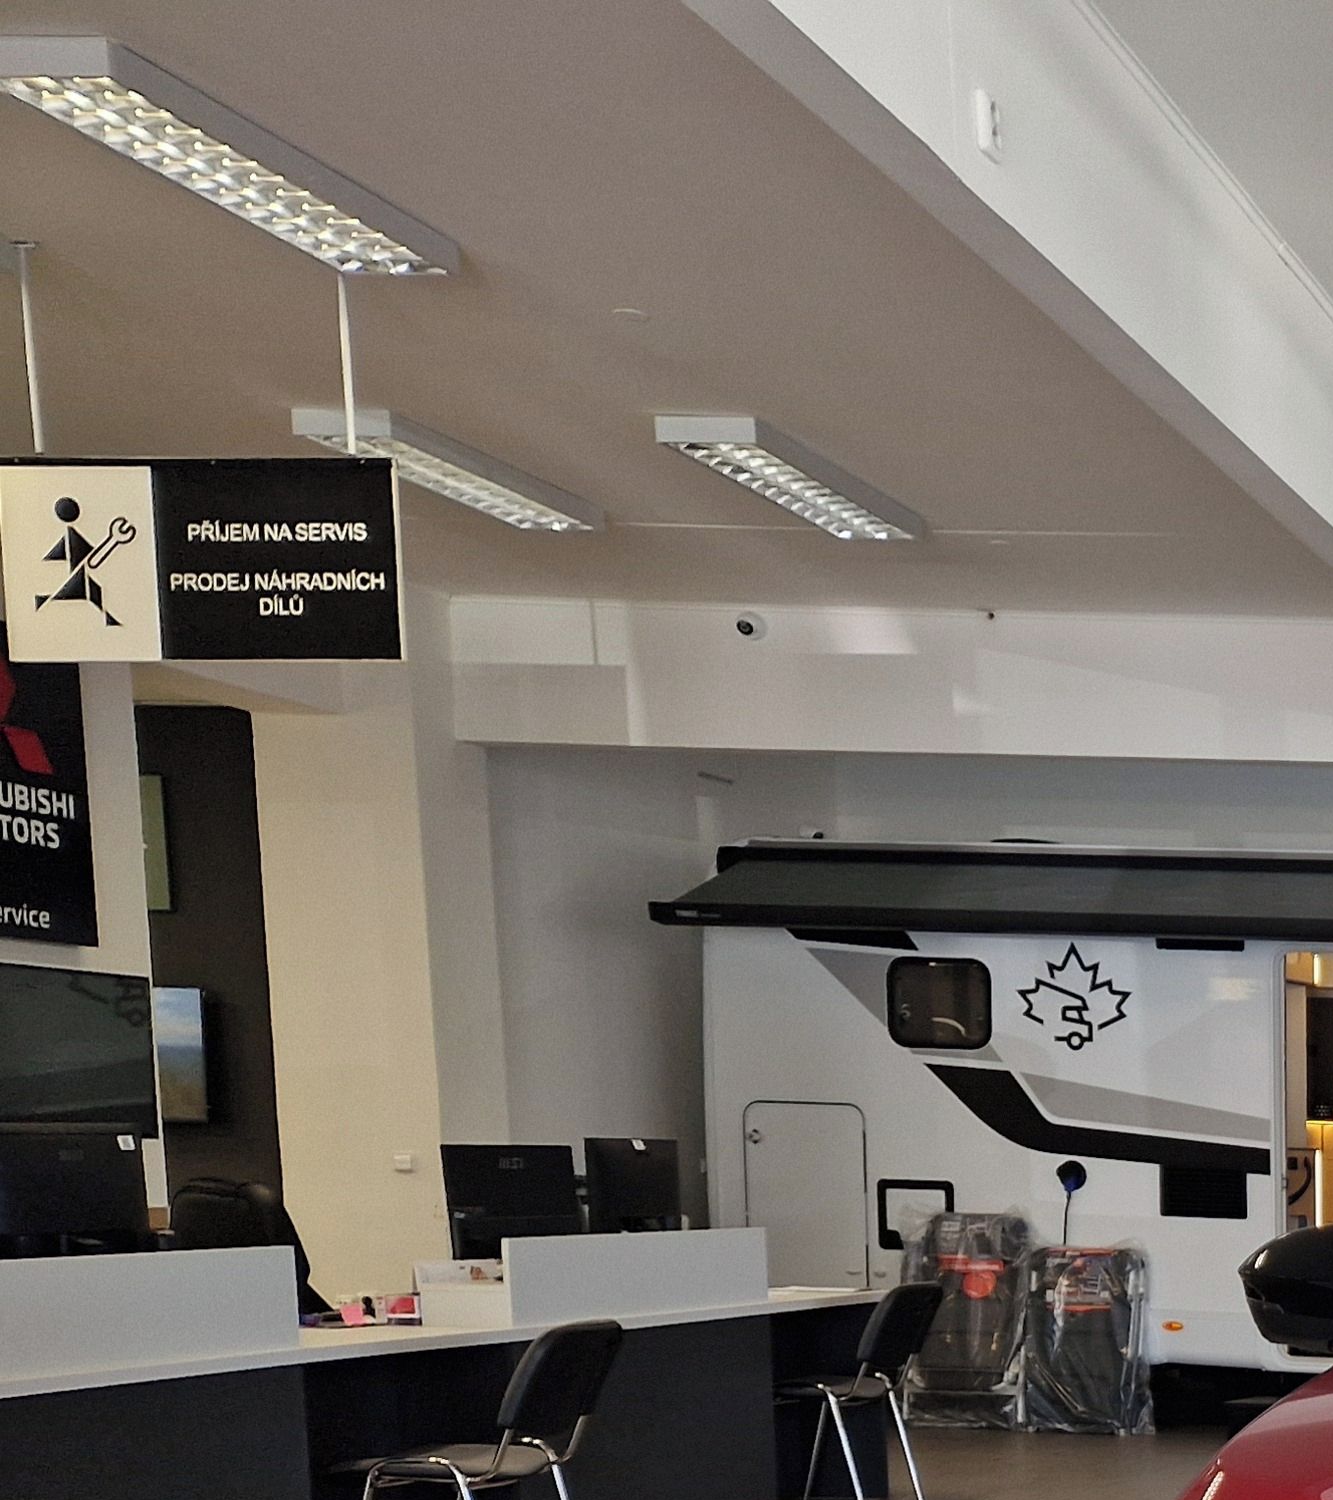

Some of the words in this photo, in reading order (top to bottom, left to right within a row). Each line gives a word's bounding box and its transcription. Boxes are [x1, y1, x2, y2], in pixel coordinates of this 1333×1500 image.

[187, 519, 260, 542] PŘÍJEM
[264, 522, 293, 542] NA
[294, 522, 368, 542] SERVIS
[170, 572, 249, 592] PRODEJ
[254, 568, 386, 592] NÁHRADNÍCH
[259, 594, 304, 616] DÍLŮ
[0, 814, 60, 849] TORS
[0, 903, 50, 929] rvice
